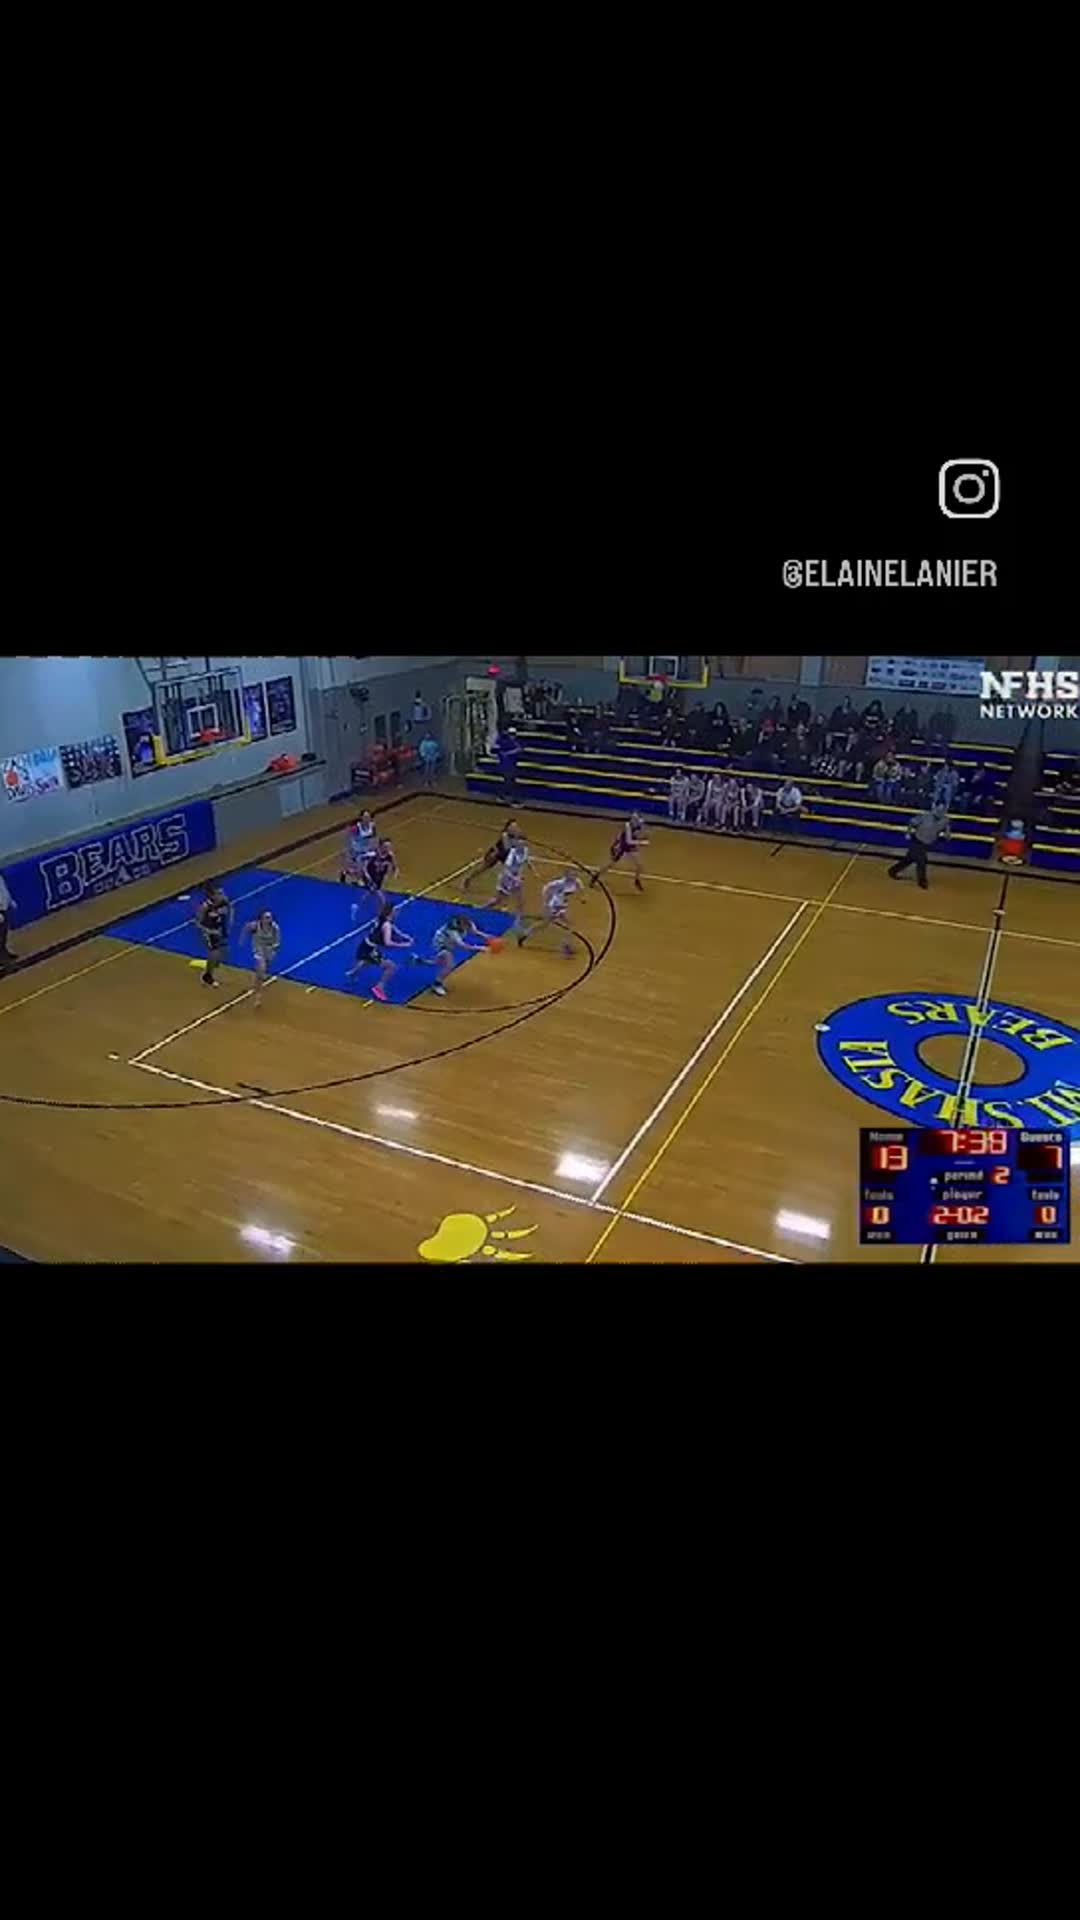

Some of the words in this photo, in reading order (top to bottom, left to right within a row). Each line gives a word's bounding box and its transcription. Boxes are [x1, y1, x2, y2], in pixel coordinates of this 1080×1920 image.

[39, 813, 189, 910] BEARS
[887, 1001, 1073, 1051] BEARS
[839, 1040, 1024, 1128] SHASTA
[879, 1145, 908, 1170] 13
[993, 1166, 1011, 1184] 2
[1043, 1145, 1063, 1169] 7
